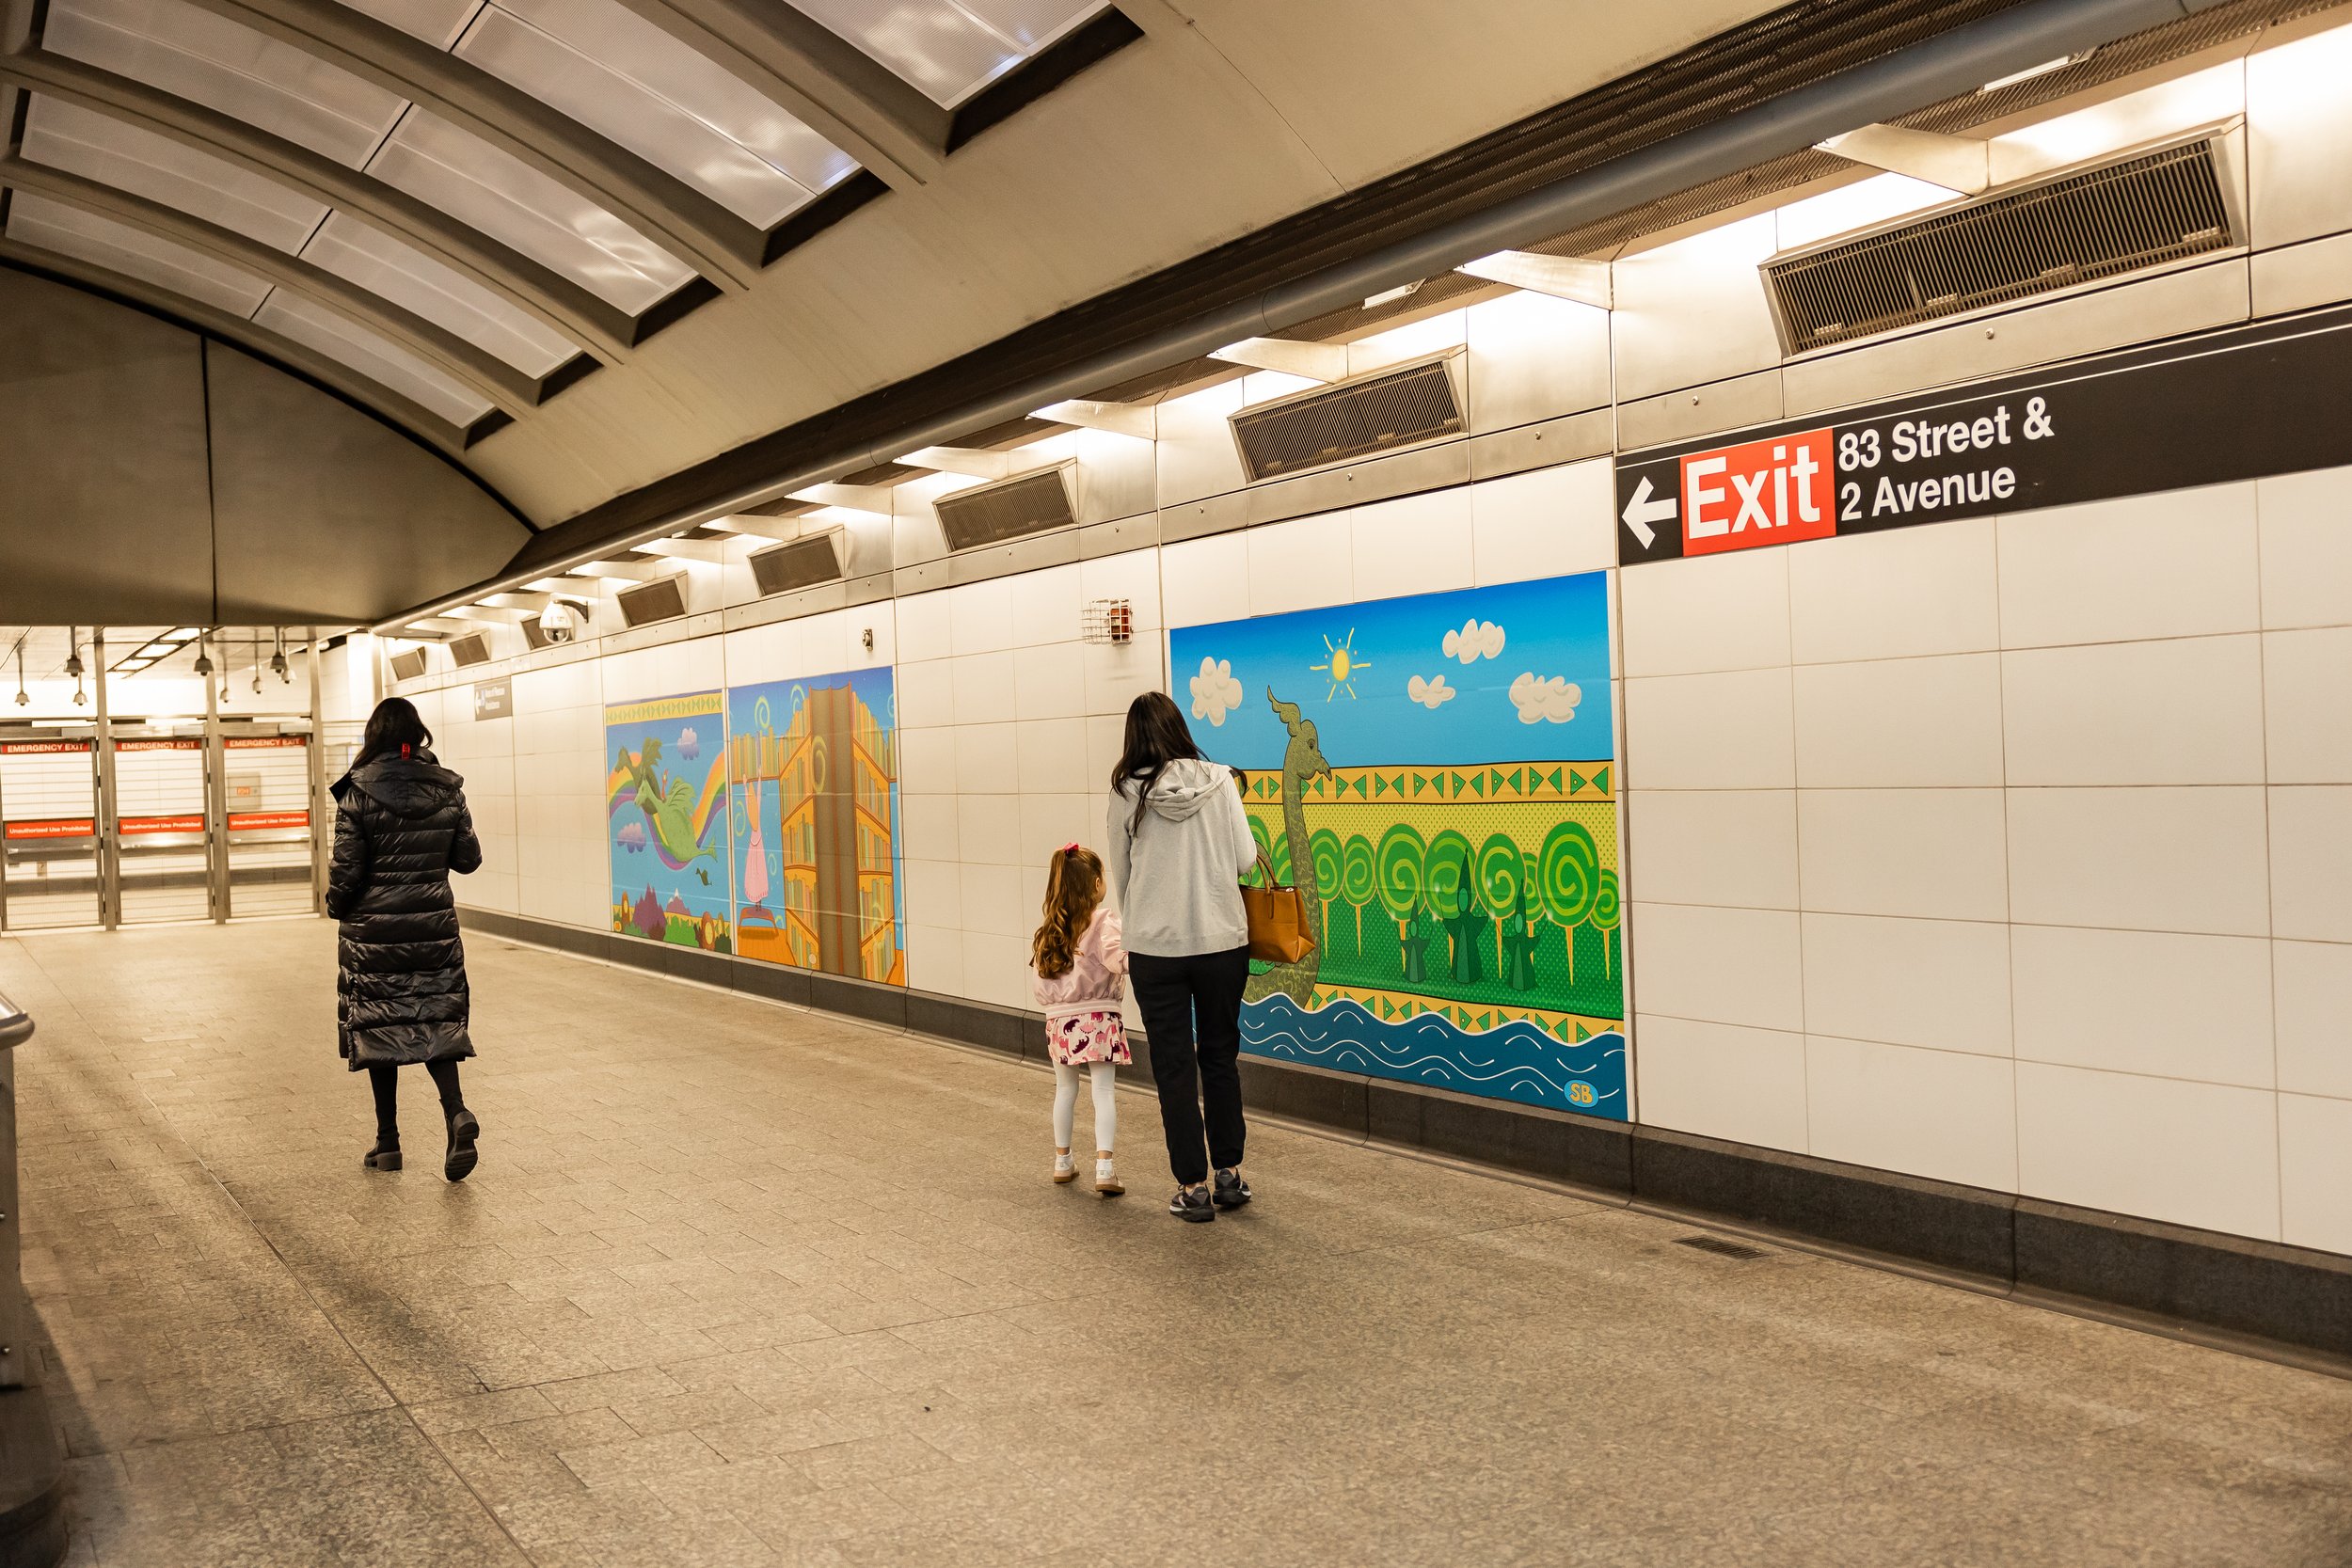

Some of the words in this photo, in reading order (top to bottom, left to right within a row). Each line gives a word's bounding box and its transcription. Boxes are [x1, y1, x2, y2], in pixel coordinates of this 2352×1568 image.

[1838, 429, 1882, 472] 83
[1891, 405, 2011, 464] Street
[2022, 396, 2056, 440] &
[1686, 444, 1821, 540] Exit
[1840, 482, 1863, 522] 2
[1871, 467, 2016, 517] Avenue
[8, 744, 63, 752] EMERGENCY
[121, 741, 174, 750] EMERGENCY
[229, 739, 280, 748] EMERGENCY
[1569, 1083, 1593, 1103] SB
